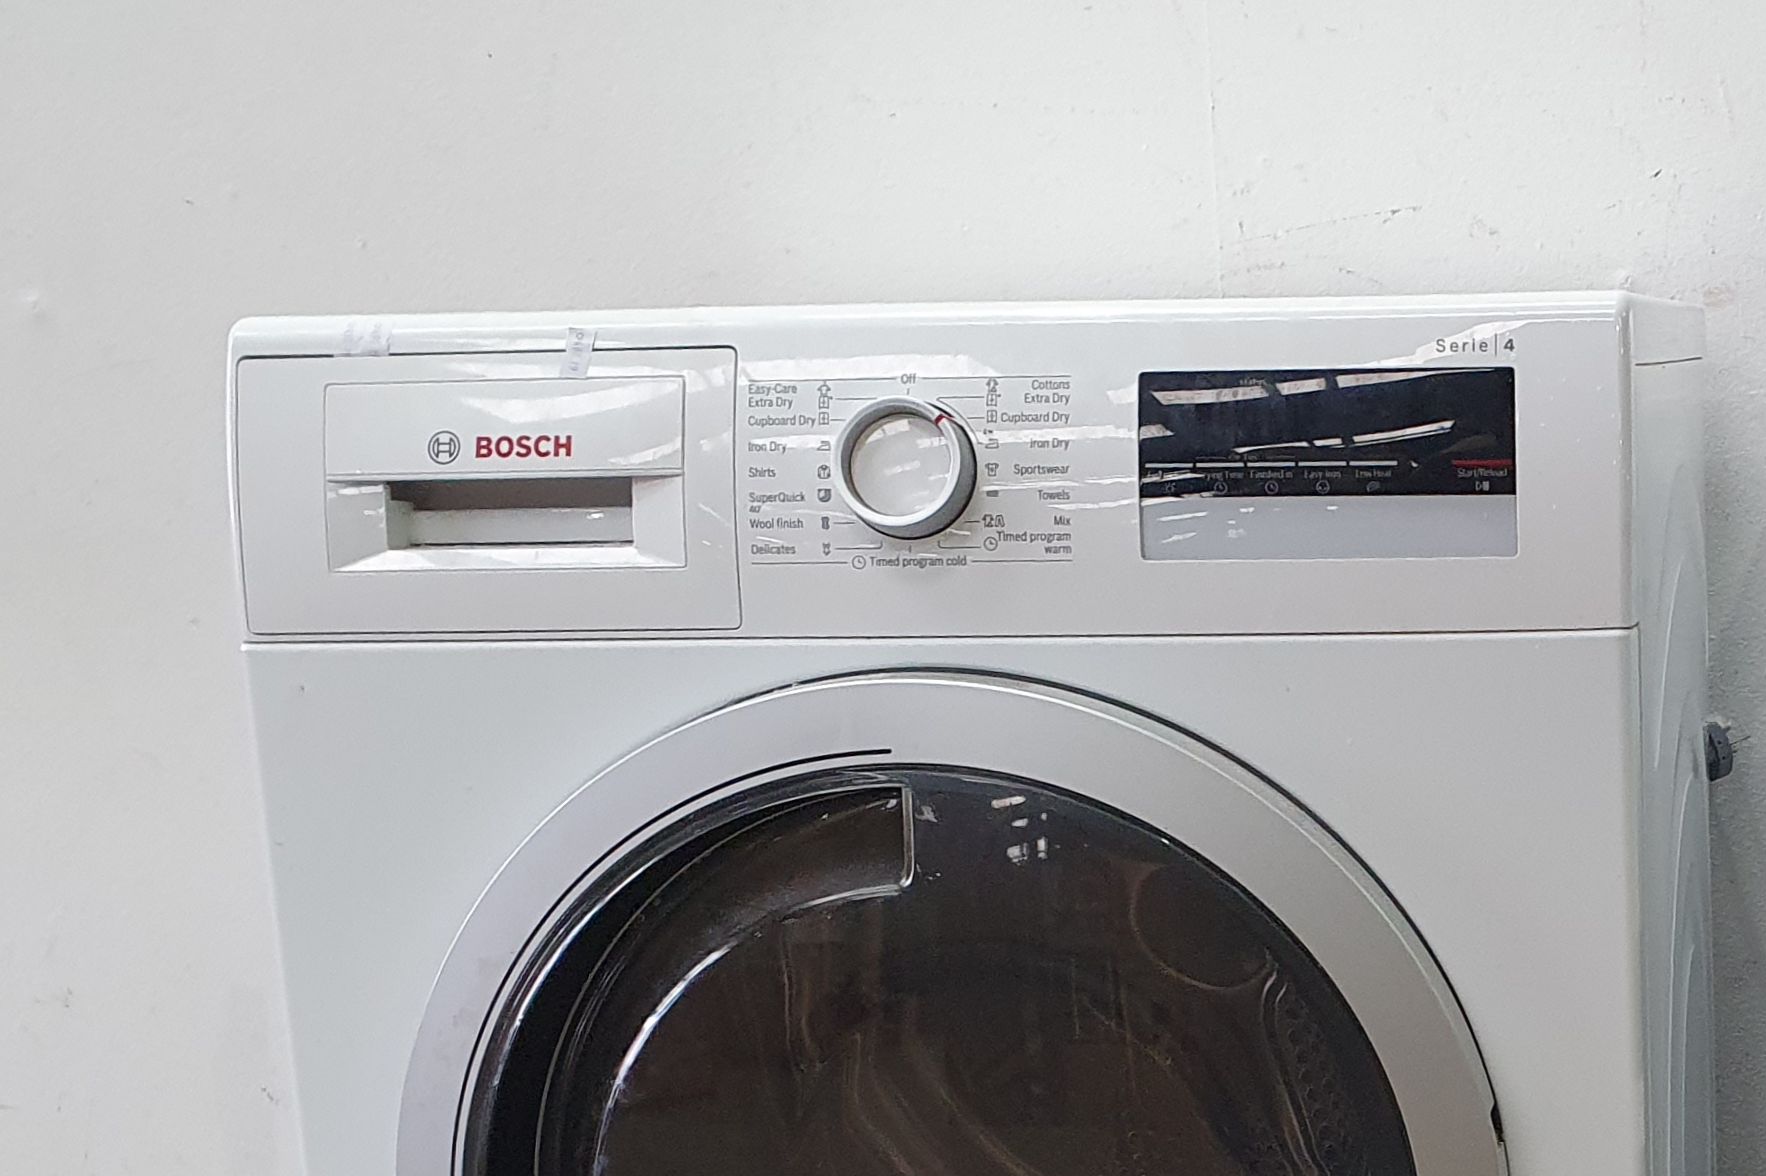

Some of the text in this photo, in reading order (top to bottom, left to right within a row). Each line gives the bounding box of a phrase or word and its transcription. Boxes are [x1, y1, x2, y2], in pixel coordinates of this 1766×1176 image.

[1435, 337, 1515, 353] Serie 4
[900, 373, 917, 384] Off
[1031, 379, 1071, 390] Cottons
[748, 383, 797, 396] Easy-Care
[748, 396, 793, 410] Extra Dry
[1024, 393, 1071, 405] Extra Dry
[748, 415, 816, 427] Cupboard Dry
[1000, 411, 1070, 424] Cupboard Dry
[474, 434, 572, 458] BOSCH
[769, 441, 787, 454] Dry
[1052, 438, 1070, 451] Dry
[748, 466, 776, 478] Shirts
[1013, 464, 1070, 477] Sportswear
[749, 491, 806, 504] SuperQuick
[1038, 489, 1071, 500] Towels
[749, 517, 804, 529] Wool finish
[1054, 515, 1071, 526] Mix
[996, 531, 1071, 544] Timed program
[751, 543, 796, 555] Delicates
[1044, 545, 1073, 554] warm
[870, 554, 967, 569] Timed program cold
